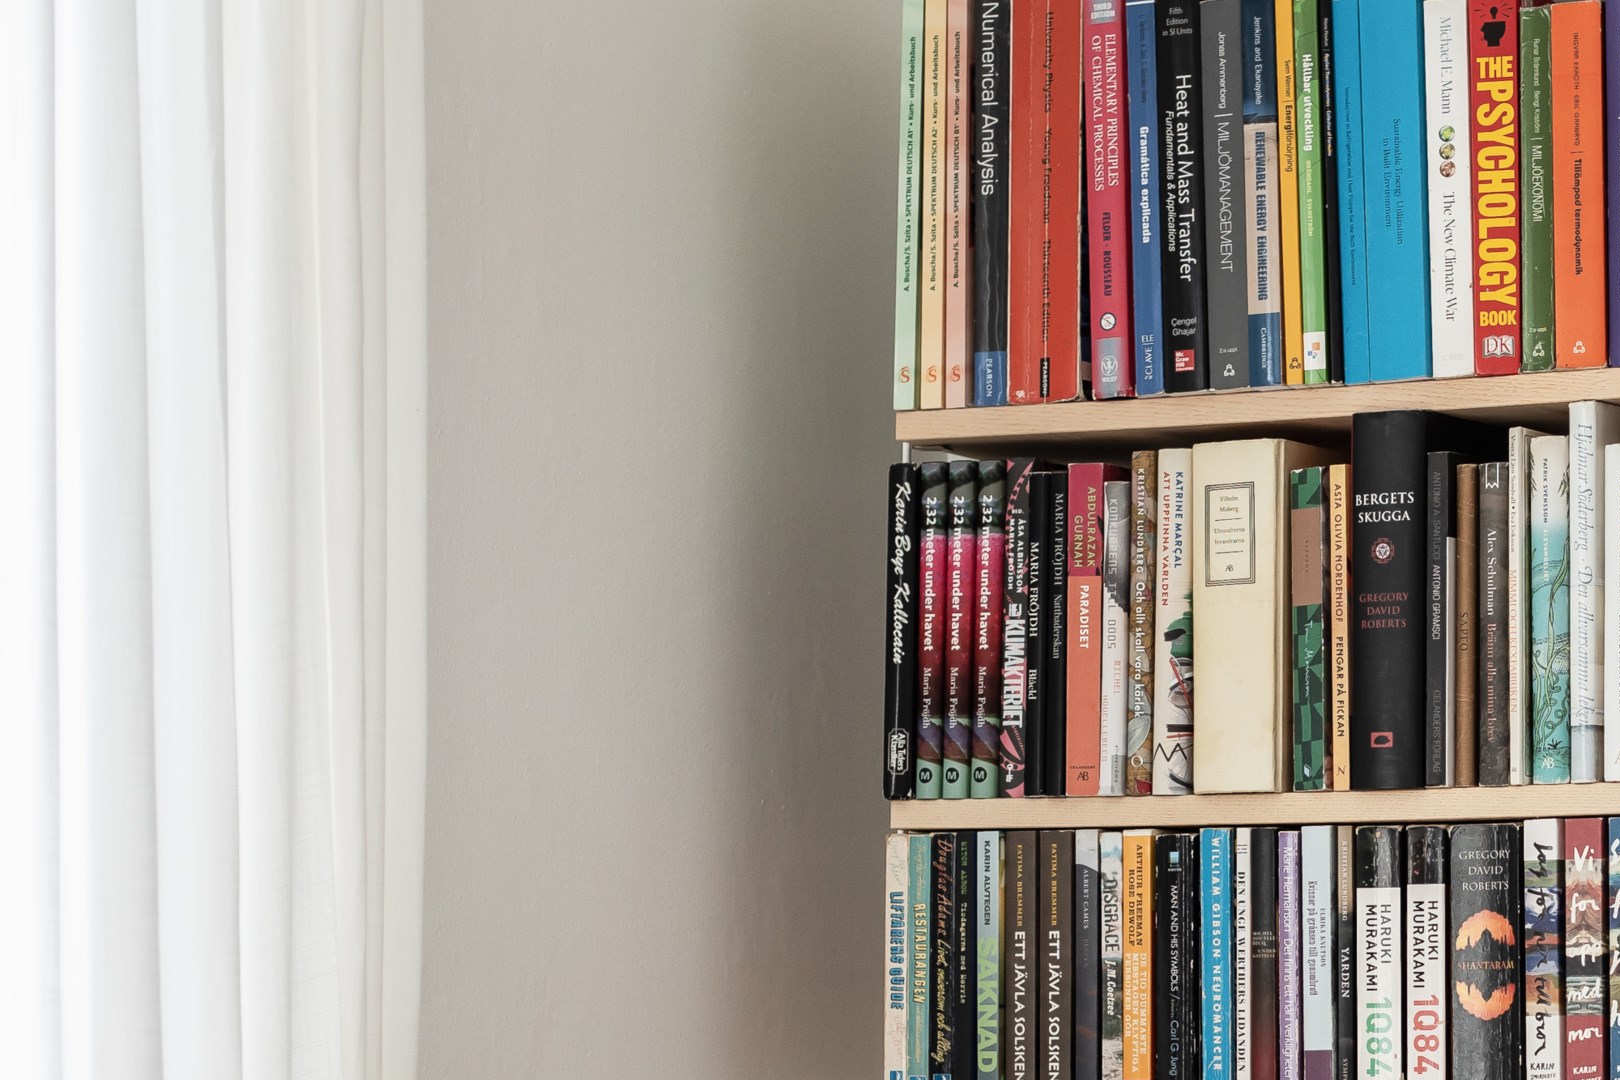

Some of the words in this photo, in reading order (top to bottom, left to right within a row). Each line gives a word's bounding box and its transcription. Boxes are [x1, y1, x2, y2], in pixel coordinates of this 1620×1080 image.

[981, 2, 998, 106] Numerical
[1093, 35, 1103, 53] OF
[1093, 56, 1104, 121] CHEMICAL
[1105, 34, 1118, 115] ELEMENTARY
[1302, 54, 1313, 95] Hållbar
[1476, 57, 1513, 78] THE
[1176, 75, 1190, 118] Heat
[1178, 122, 1192, 156] and
[1302, 98, 1315, 150] utveckling
[978, 114, 998, 195] Analysis
[1094, 125, 1105, 191] PROCESSES
[1107, 118, 1118, 186] PRINCIPLES
[1140, 127, 1151, 185] Gramática
[1255, 132, 1267, 191] RENEWABLE
[1179, 161, 1193, 203] Mass
[1217, 122, 1234, 272] MILJÖMANAGEMENT
[1444, 192, 1455, 215] The
[1477, 82, 1516, 306] PSYCHOLOGY
[1532, 145, 1544, 221] MILJÖEKONOMI
[1573, 159, 1582, 206] Tillämpad
[1139, 189, 1152, 243] explicada
[1256, 194, 1267, 232] ENERGY
[1444, 219, 1455, 245] New
[1180, 209, 1195, 281] Transfer
[1573, 208, 1583, 275] termodynamik
[1257, 236, 1268, 300] ENGINEERING
[1444, 248, 1457, 294] Climate
[1446, 298, 1457, 321] War
[1480, 311, 1516, 326] BOOK
[985, 358, 993, 397] PEARSON
[1163, 472, 1171, 491] ATT
[1356, 495, 1414, 505] BERGETS
[895, 482, 909, 532] Karin
[925, 497, 936, 525] 2,32
[953, 496, 964, 524] 2,32
[981, 495, 992, 524] 2,32
[1087, 487, 1096, 567] ABDULRAZAK
[1162, 495, 1170, 551] UPPFINNA
[1358, 511, 1411, 523] SKUGGA
[893, 535, 908, 574] Boye
[924, 529, 935, 567] meter
[953, 528, 963, 566] meter
[981, 526, 992, 566] meter
[1074, 515, 1083, 567] GURNAH
[1136, 520, 1144, 573] LUNDBERG
[923, 571, 934, 610] under
[951, 570, 962, 609] under
[980, 569, 991, 608] under
[1135, 582, 1145, 602] Och
[1161, 556, 1171, 606] VÄRLDEN
[1360, 593, 1409, 602] GREGORY
[892, 583, 909, 664] Kallocain
[923, 614, 933, 651] havet
[950, 613, 961, 650] havet
[979, 612, 990, 649] havet
[1080, 585, 1089, 648] PARADISET
[1135, 606, 1144, 624] allt
[1367, 607, 1400, 615] DAVID
[1135, 628, 1144, 652] skall
[1336, 637, 1344, 679] PENGAR
[1135, 657, 1143, 680] vara
[1336, 683, 1347, 696] PÅ
[1134, 684, 1144, 717] kärlek
[1337, 700, 1345, 737] FICKAN
[1212, 838, 1221, 895] WILLIAM
[1459, 850, 1510, 859] GREGORY
[1238, 872, 1246, 895] DEN
[891, 892, 904, 963] LIFTARENS
[1212, 904, 1221, 957] GIBSON
[1238, 901, 1246, 932] UNGE
[1381, 905, 1391, 963] HARUKI
[1428, 901, 1438, 960] HARUKI
[914, 903, 926, 1003] RESTAURANGEN
[1015, 931, 1025, 959] ETT
[1049, 930, 1060, 959] ETT
[1366, 905, 1378, 991] MURAKAMI
[1413, 901, 1424, 988] MURAKAMI
[890, 968, 904, 1009] GUIDE
[1015, 963, 1027, 1011] JÄVLA
[1049, 963, 1061, 1012] JÄVLA
[1238, 938, 1246, 1004] WERTHERS
[1341, 948, 1349, 998] YARDEN
[978, 937, 997, 1072] SAKNAD
[1212, 966, 1221, 1070] NEUROMANCER
[1238, 1010, 1246, 1071] LIDANDEN
[1366, 997, 1392, 1076] 1Q84
[1413, 995, 1439, 1074] 1Q84
